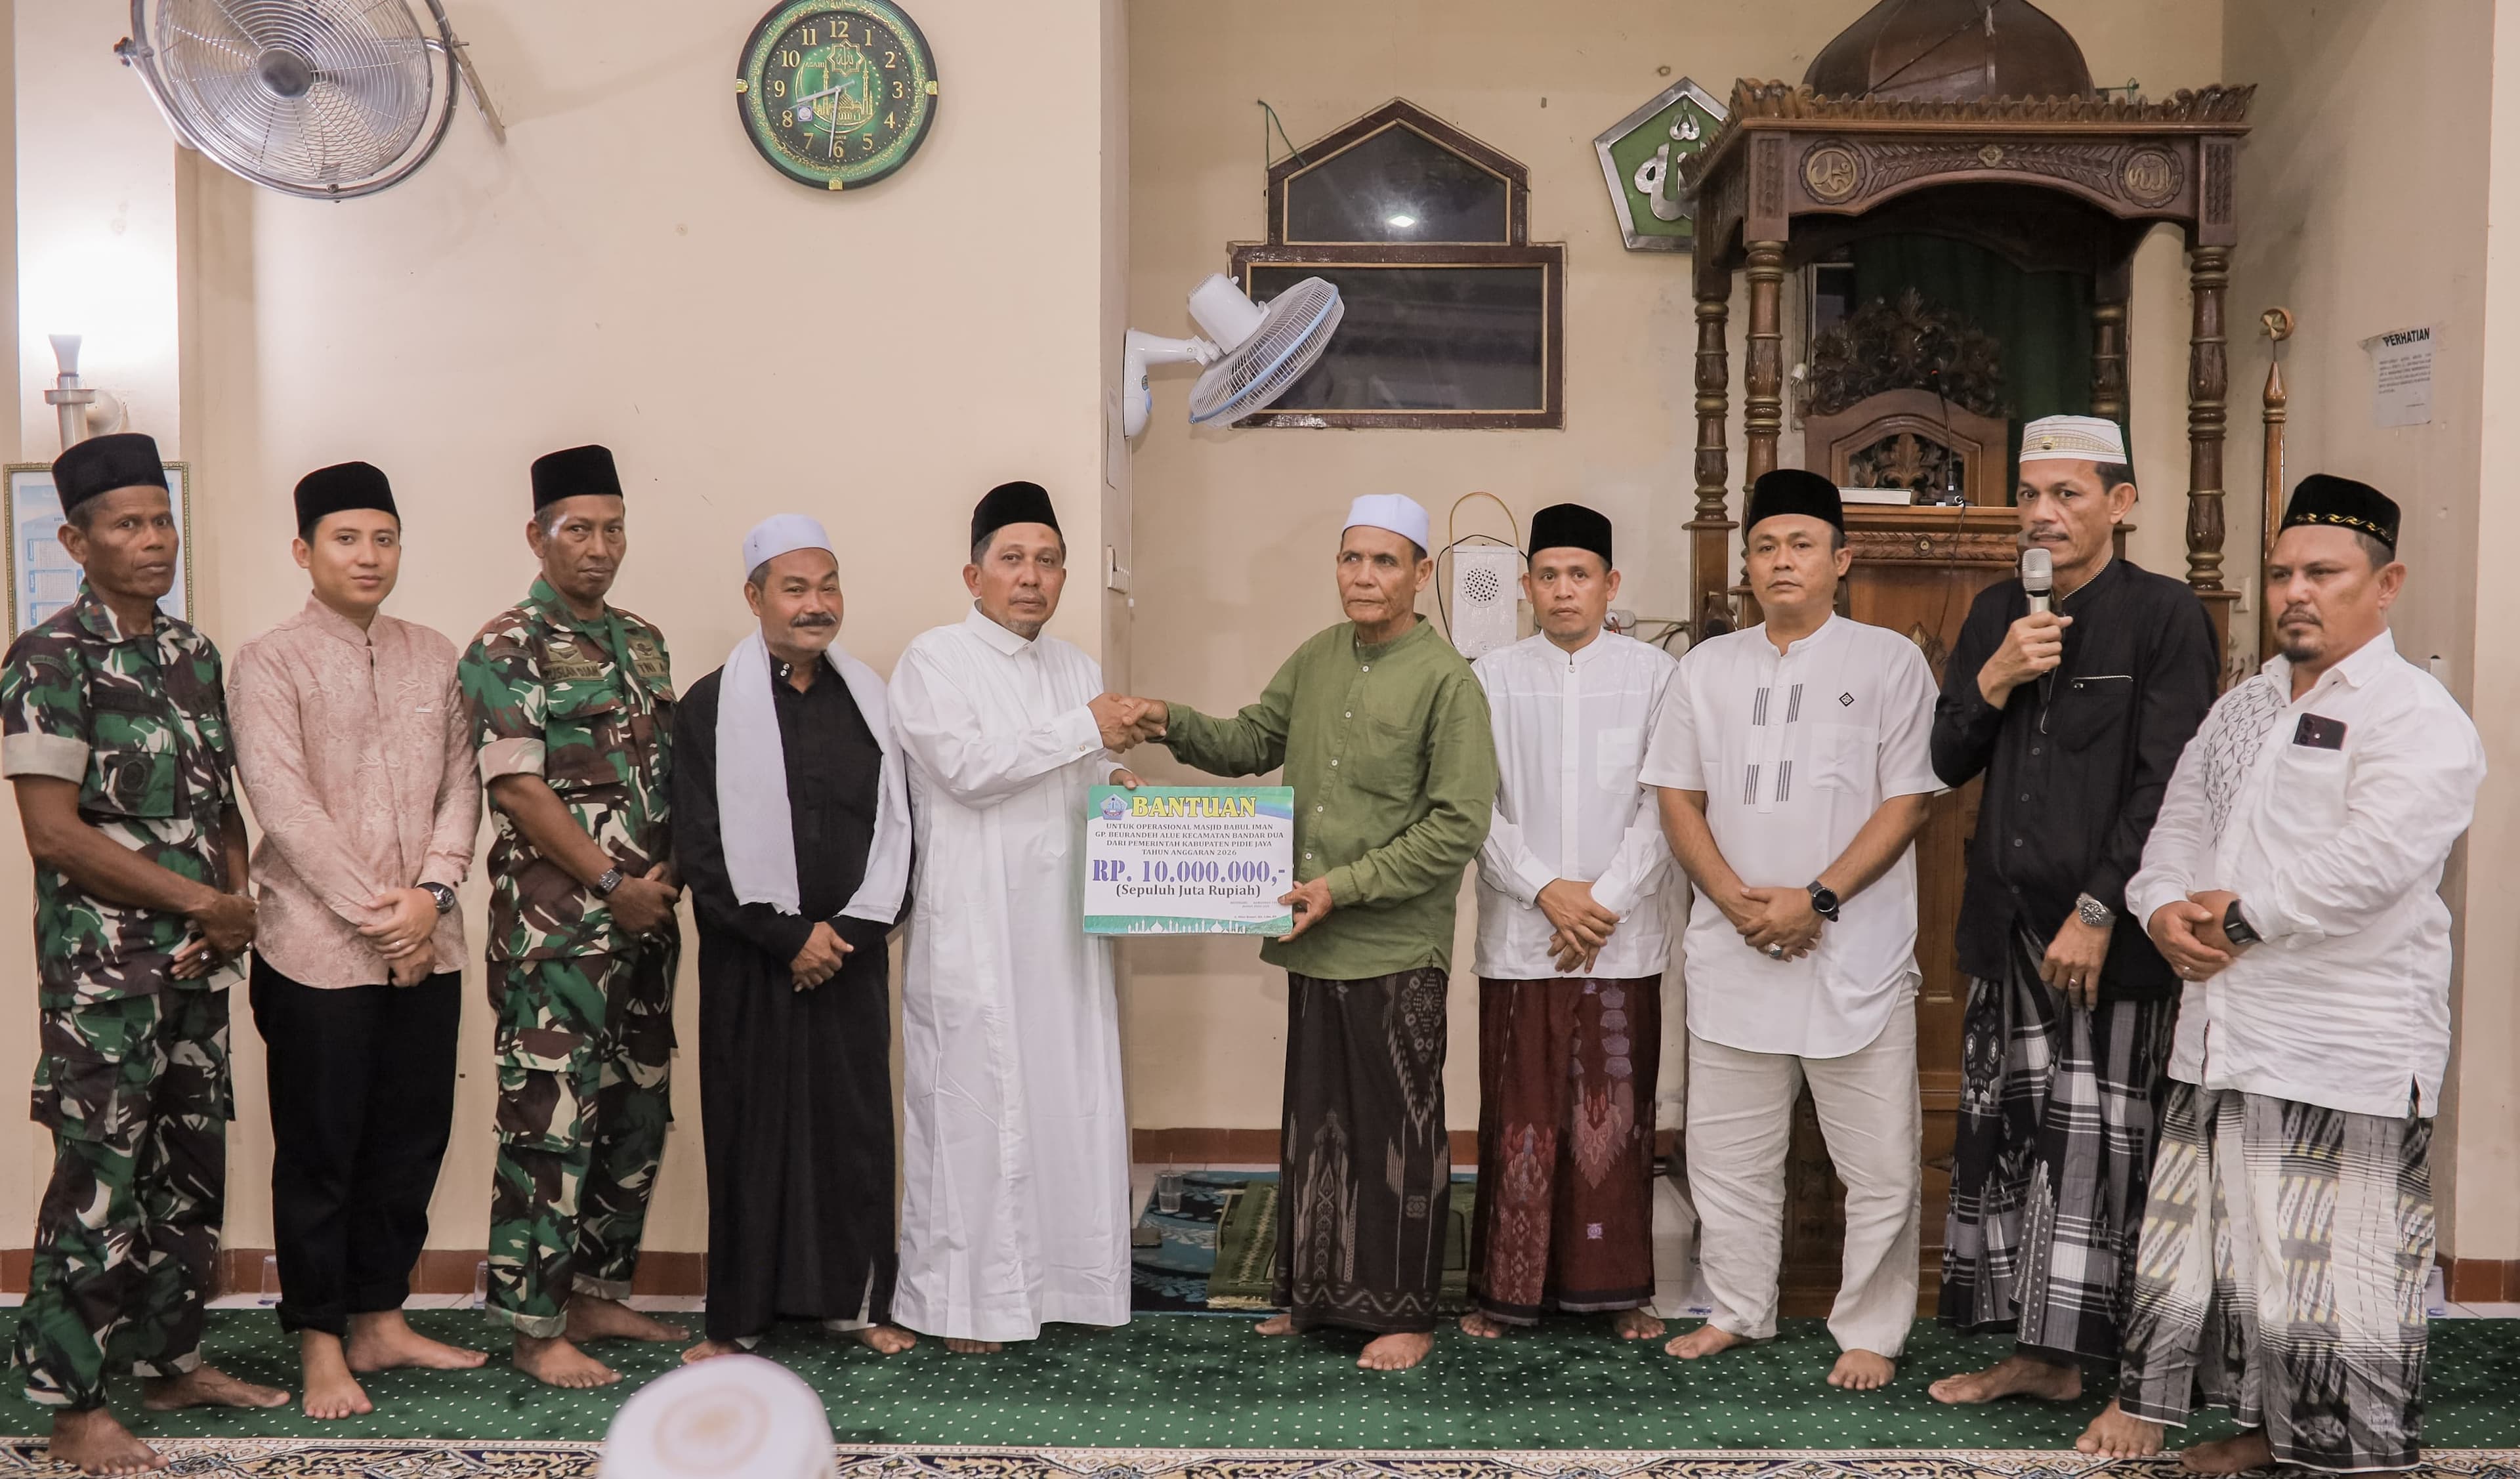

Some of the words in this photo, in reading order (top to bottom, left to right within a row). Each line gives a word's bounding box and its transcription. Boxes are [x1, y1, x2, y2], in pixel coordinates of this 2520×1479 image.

[802, 28, 818, 46] 11
[830, 20, 849, 37] 12
[865, 29, 872, 46] 1
[782, 51, 801, 68] 10
[885, 51, 896, 68] 2
[774, 80, 786, 98] 9
[892, 81, 904, 98] 3
[782, 110, 793, 127] 8
[884, 111, 896, 129] 4
[803, 133, 814, 150] 7
[833, 140, 844, 158] 6
[862, 133, 873, 150] 5
[2382, 327, 2430, 346] PERHATIAN
[1131, 796, 1256, 818] BANTUAN
[1093, 860, 1132, 883] RP.
[1143, 860, 1285, 886] 10.000.000,-
[1116, 885, 1175, 898] (Sepuluh
[1179, 885, 1205, 898] Juta
[1209, 885, 1261, 898] Rupiah)
